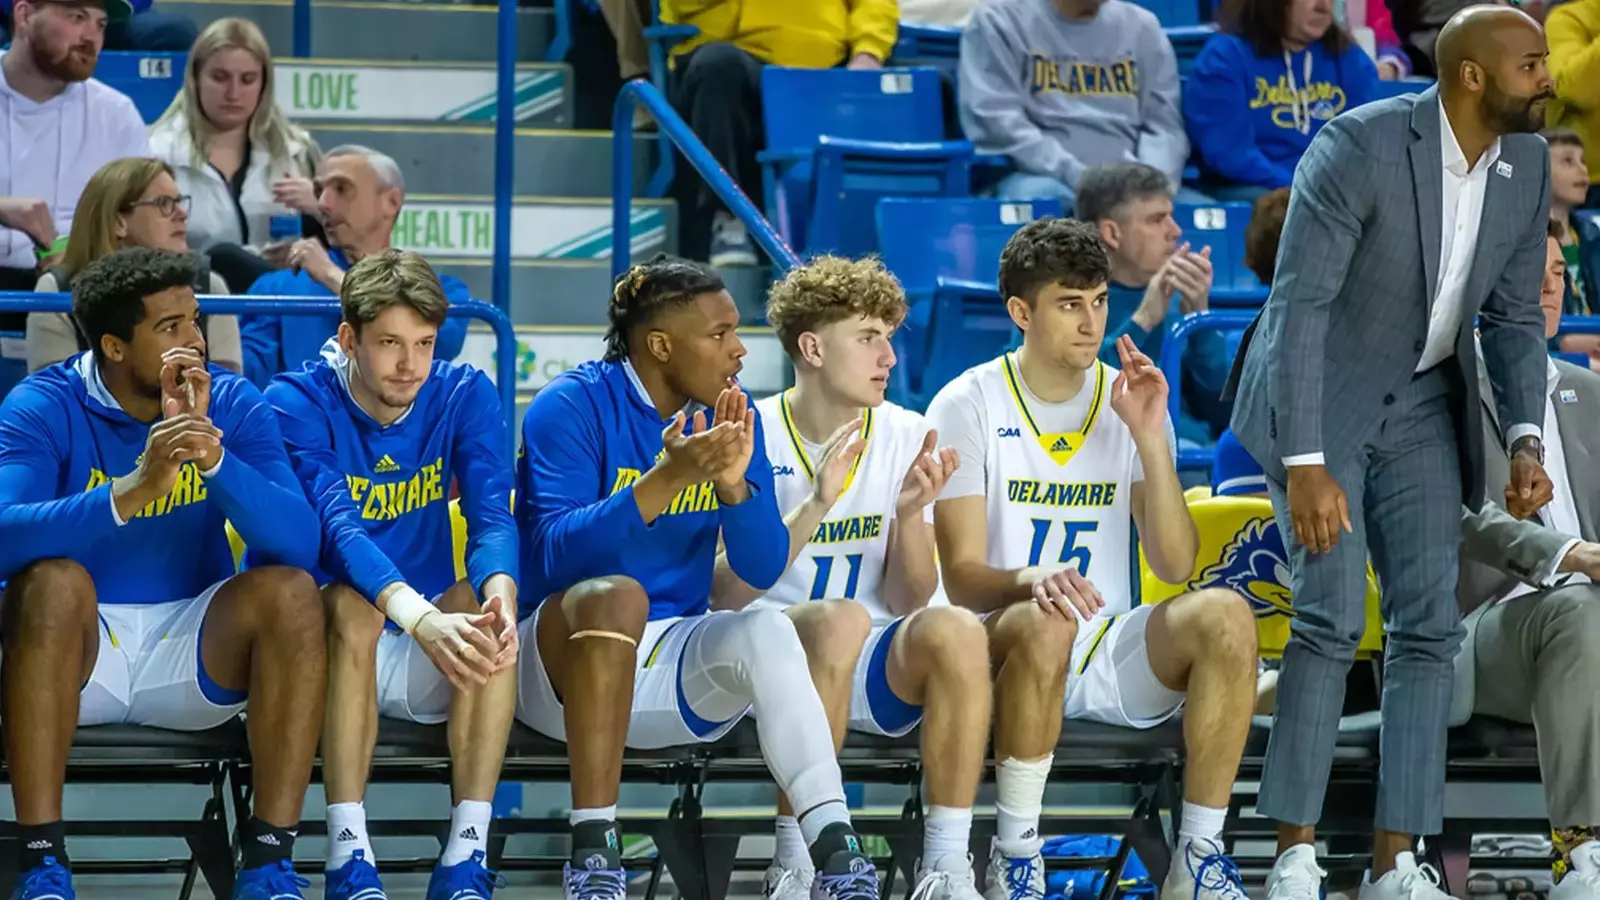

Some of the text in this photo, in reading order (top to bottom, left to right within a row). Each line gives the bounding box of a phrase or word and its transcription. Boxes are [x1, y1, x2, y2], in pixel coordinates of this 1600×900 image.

[293, 71, 358, 110] LOVE
[393, 210, 490, 249] HEALTH
[997, 428, 1021, 437] CAA
[1008, 479, 1117, 507] DELAWARE
[808, 514, 883, 544] AWARE
[1027, 518, 1099, 578] 15
[808, 553, 863, 600] 11
